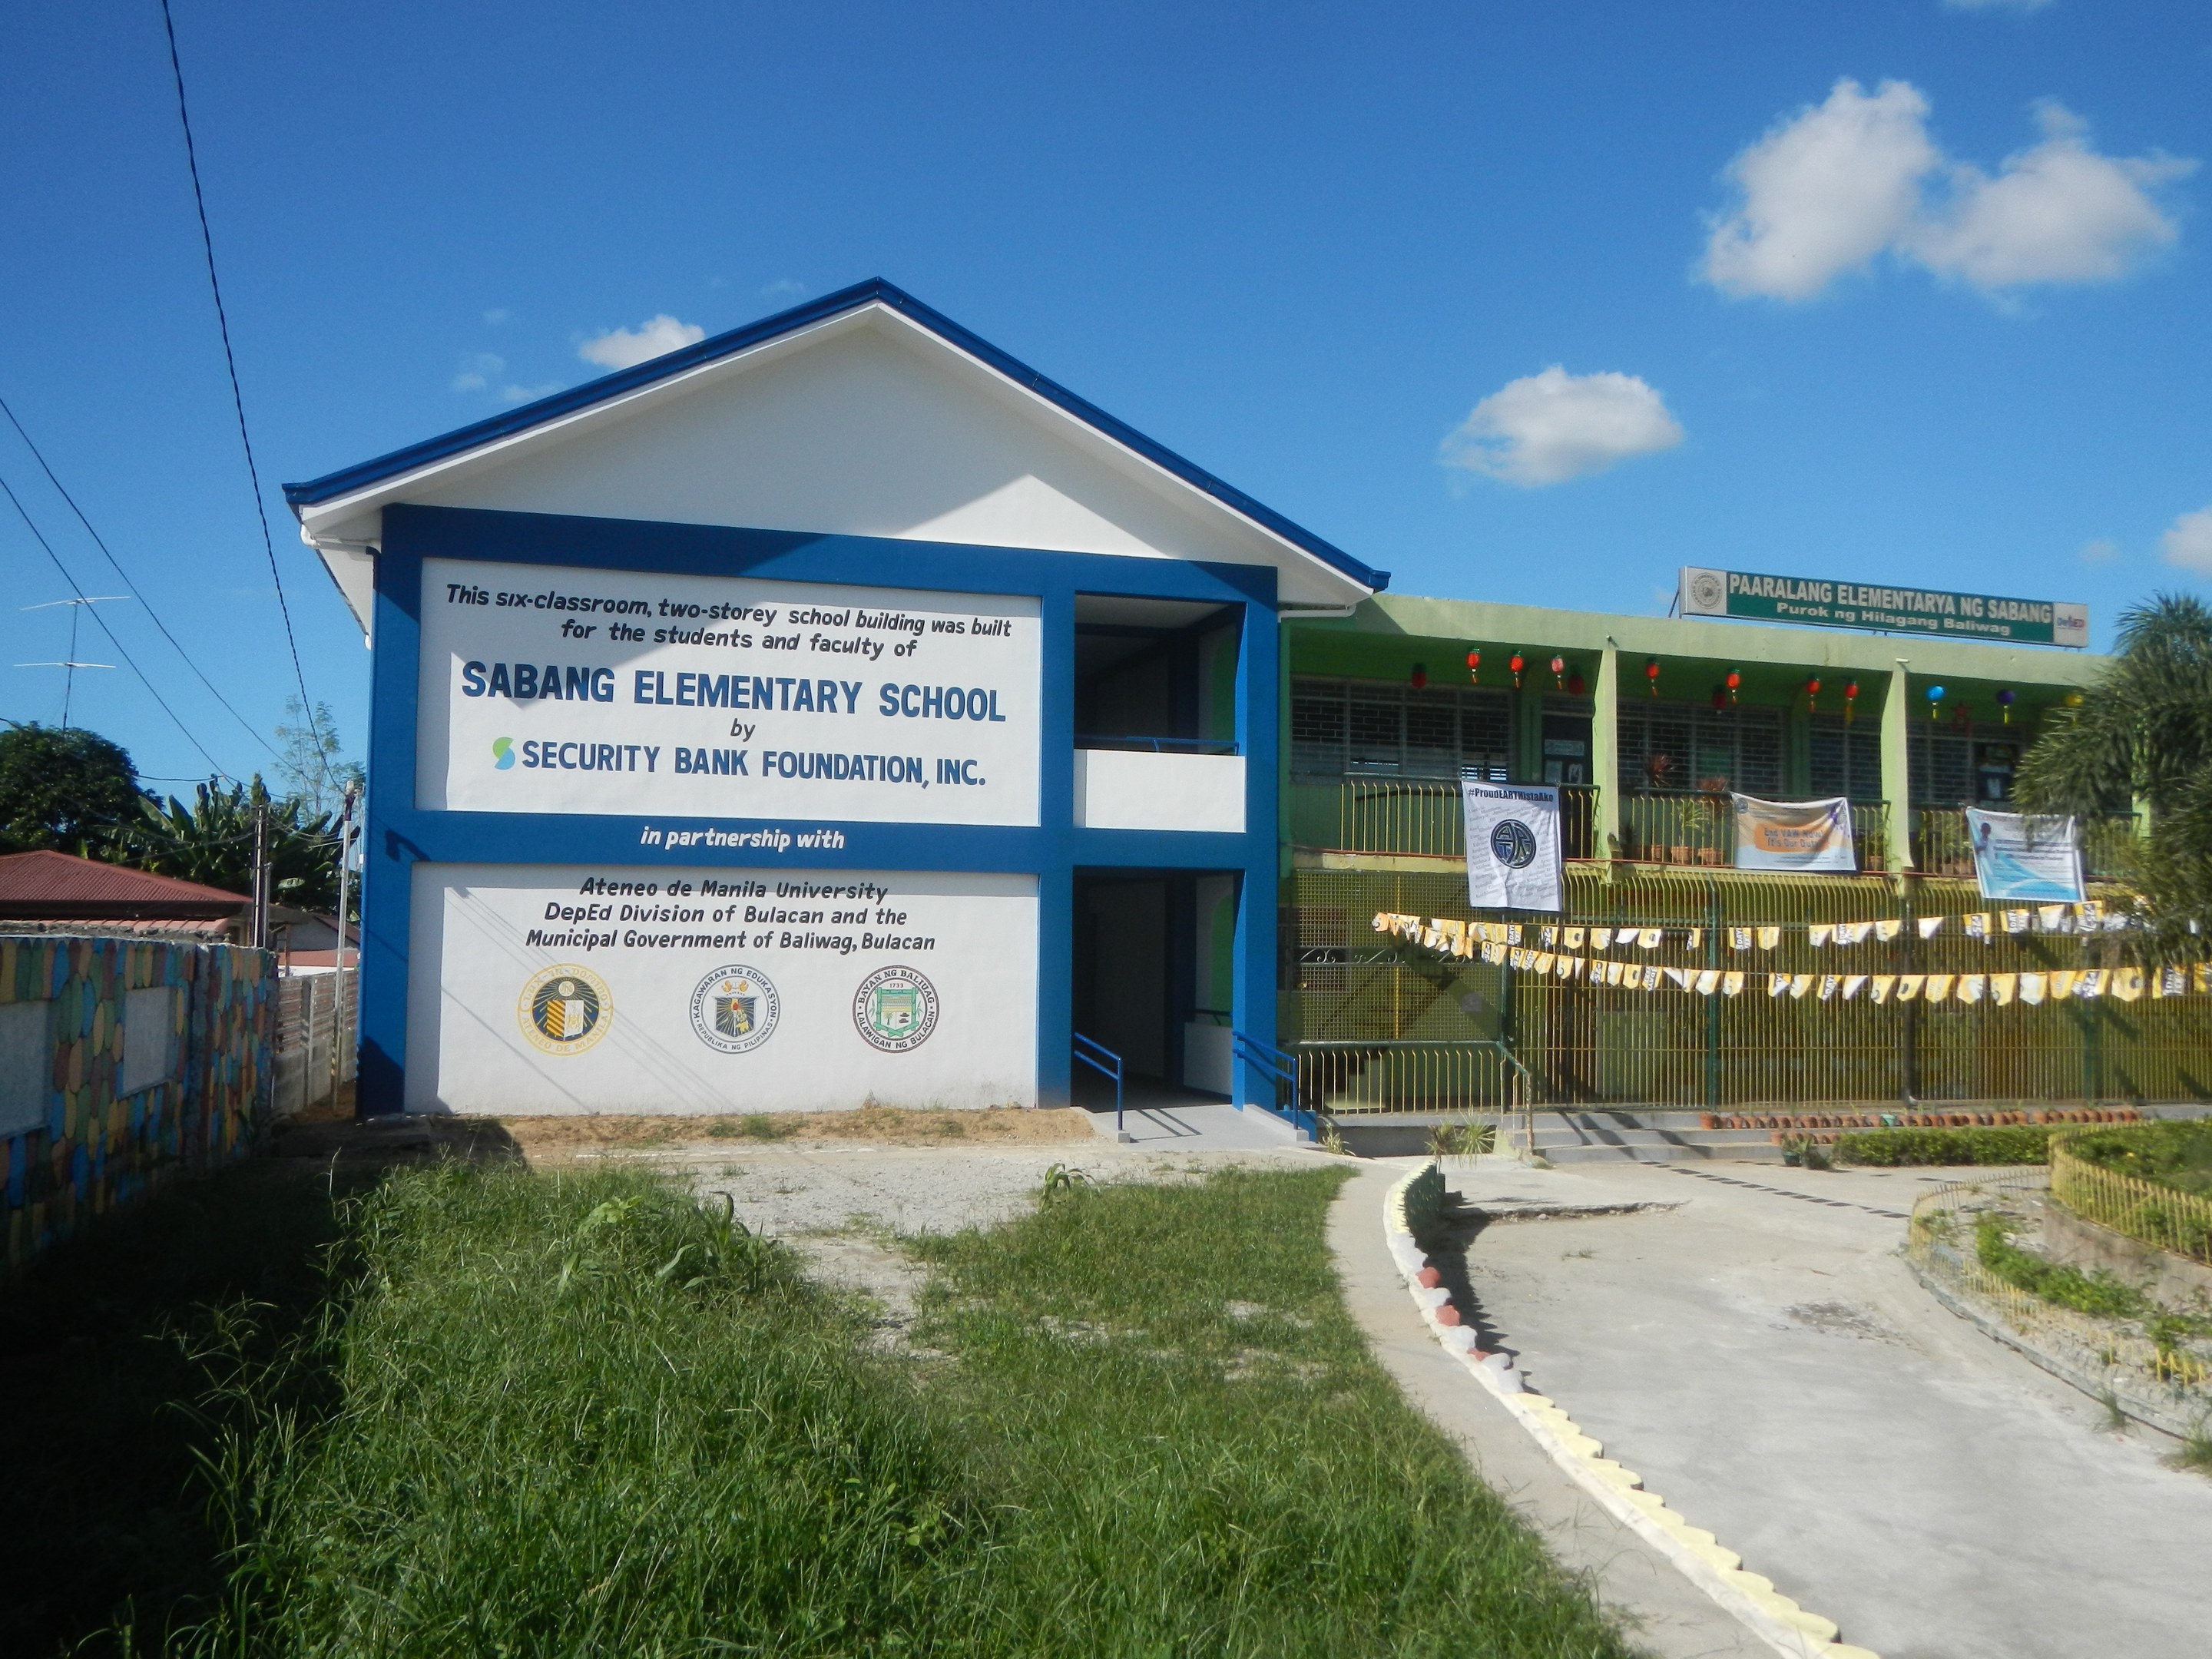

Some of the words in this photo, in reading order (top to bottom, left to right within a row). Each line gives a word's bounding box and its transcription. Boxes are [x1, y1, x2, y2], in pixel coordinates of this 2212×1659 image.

[446, 583, 490, 606] This
[495, 590, 652, 618] six-classroom,
[657, 598, 778, 628] two-storey
[788, 608, 851, 627] school
[855, 609, 926, 637] building
[931, 620, 965, 634] was
[971, 617, 1012, 637] built
[1730, 575, 1832, 603] PAARALANG
[1837, 584, 1955, 614] ELEMENTARYA
[1960, 597, 1982, 618] NG
[1988, 600, 2051, 623] SABANG
[1777, 601, 1829, 618] Purok
[1834, 609, 1856, 624] ng
[1861, 609, 1939, 630] Hilagang
[1943, 618, 2010, 637] Baliwag
[561, 618, 598, 640] for
[608, 621, 646, 643] the
[653, 625, 753, 648] students
[761, 633, 801, 651] and
[809, 632, 885, 661] faculty
[893, 639, 918, 657] of
[462, 661, 615, 703] SABANG
[634, 670, 863, 714] ELEMENTARY
[879, 682, 1006, 722] SCHOOL
[730, 717, 756, 743] by
[522, 740, 661, 773] SECURITY
[674, 747, 749, 777] BANK
[762, 750, 929, 790] FOUNDATION,
[936, 758, 986, 786] INC.
[640, 826, 661, 845] in
[664, 827, 791, 853] partnership
[796, 829, 845, 849] with
[579, 876, 658, 897] Ateneo
[667, 879, 692, 897] de
[700, 879, 767, 898] Manila
[776, 881, 889, 906] University
[544, 902, 613, 926] DepEd
[619, 904, 705, 923] Division
[712, 904, 737, 922] of
[743, 905, 824, 924] Bulacan
[830, 907, 869, 925] and
[875, 908, 907, 926] the
[525, 928, 618, 952] Municipal
[623, 929, 747, 949] Government
[753, 930, 775, 949] of
[779, 931, 858, 955] Baliwag,
[861, 932, 935, 950] Bulacan
[693, 969, 727, 1018] KAGAWARAN
[746, 969, 777, 1018] EDUKASYON
[857, 974, 882, 1004] BAYAN
[883, 969, 897, 979] NG
[899, 969, 935, 1004] BALIUAG
[522, 1018, 552, 1049] ATENEO
[575, 1016, 608, 1049] MANILA
[697, 1022, 727, 1049] REPUBLIKA
[743, 1022, 773, 1048] PILIPINAS
[856, 1012, 891, 1048] LALAWIGAN
[909, 1011, 935, 1045] BULACAN
